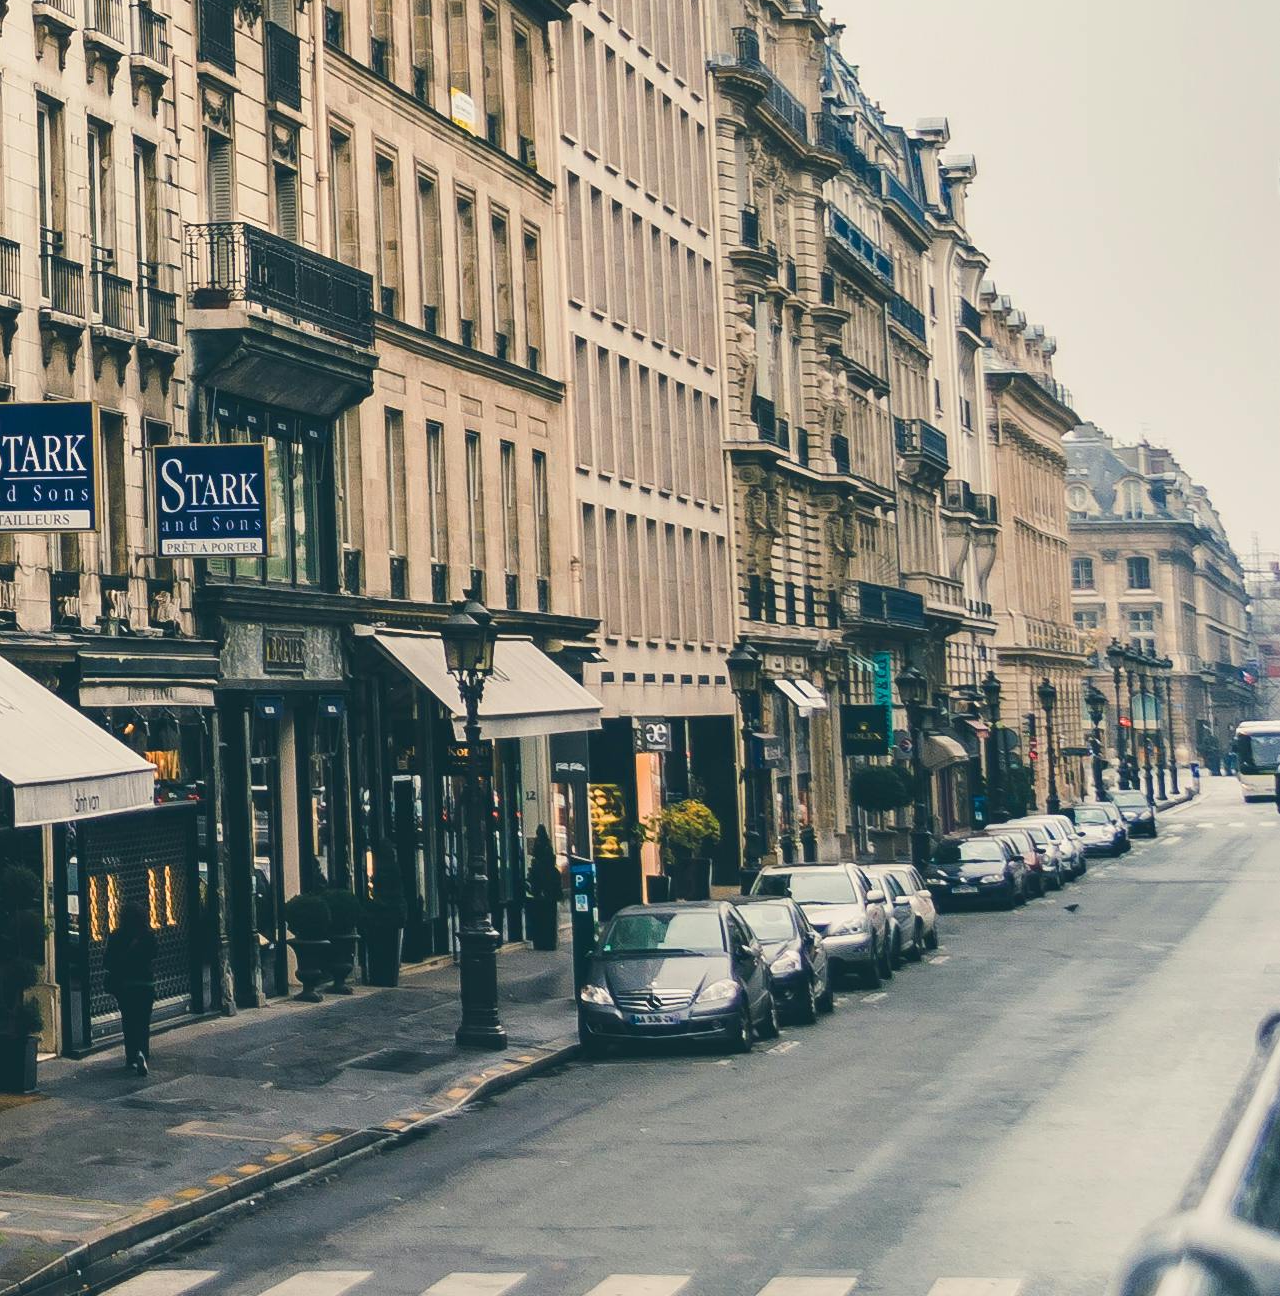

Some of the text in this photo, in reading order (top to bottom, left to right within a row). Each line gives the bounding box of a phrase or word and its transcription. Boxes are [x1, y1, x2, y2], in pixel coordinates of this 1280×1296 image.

[33, 484, 89, 502] Sons
[161, 458, 259, 513] STARK
[162, 515, 261, 532] and Sons
[166, 541, 196, 553] PRÊT
[211, 542, 258, 553] PORTER
[526, 791, 536, 801] 12
